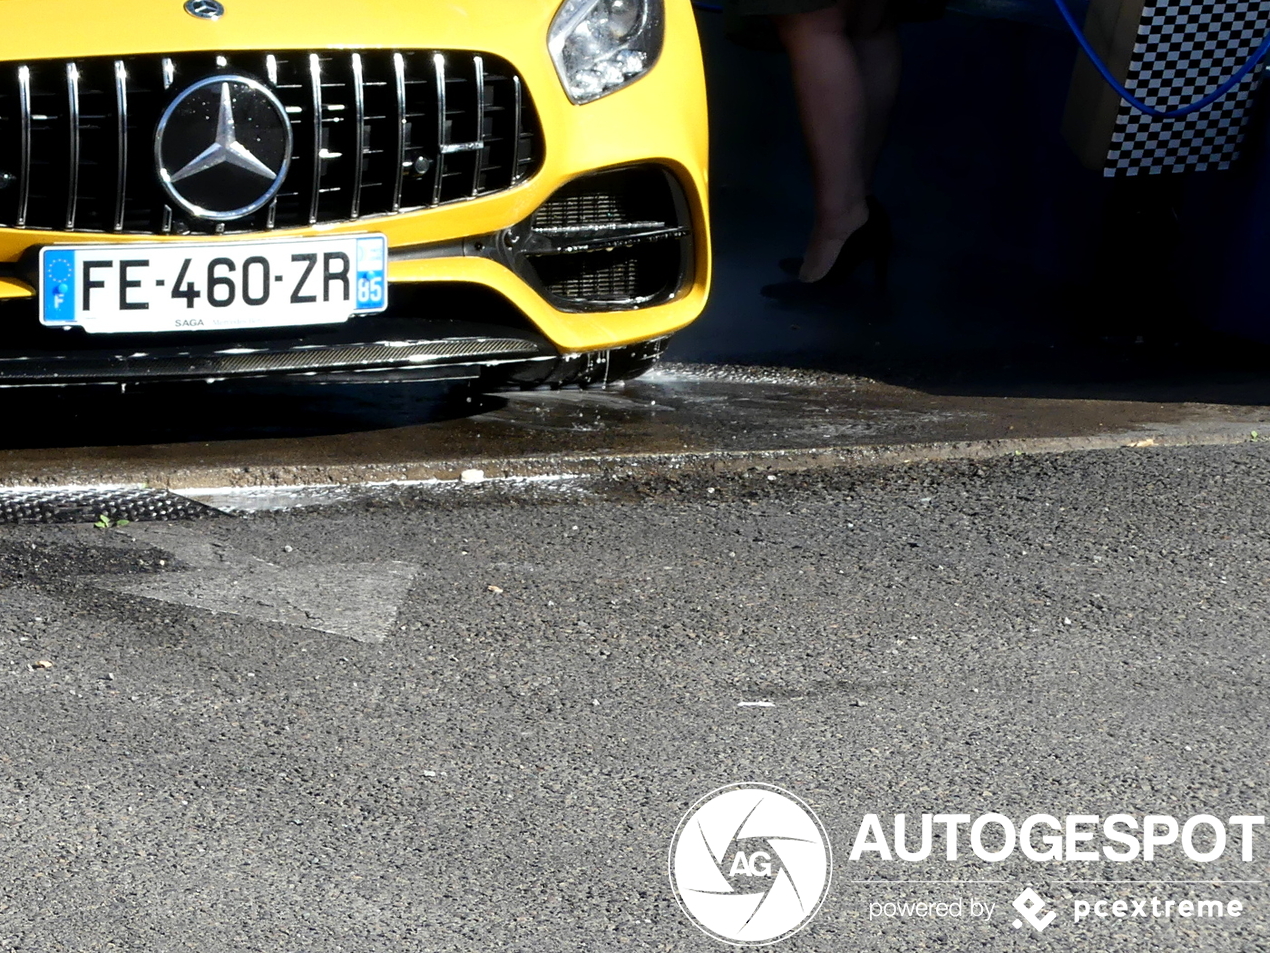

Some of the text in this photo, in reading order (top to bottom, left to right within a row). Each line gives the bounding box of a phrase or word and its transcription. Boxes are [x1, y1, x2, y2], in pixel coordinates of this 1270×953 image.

[82, 251, 350, 311] FE-460-ZR
[357, 277, 382, 302] 85
[54, 293, 65, 309] F
[174, 318, 205, 327] SAGA
